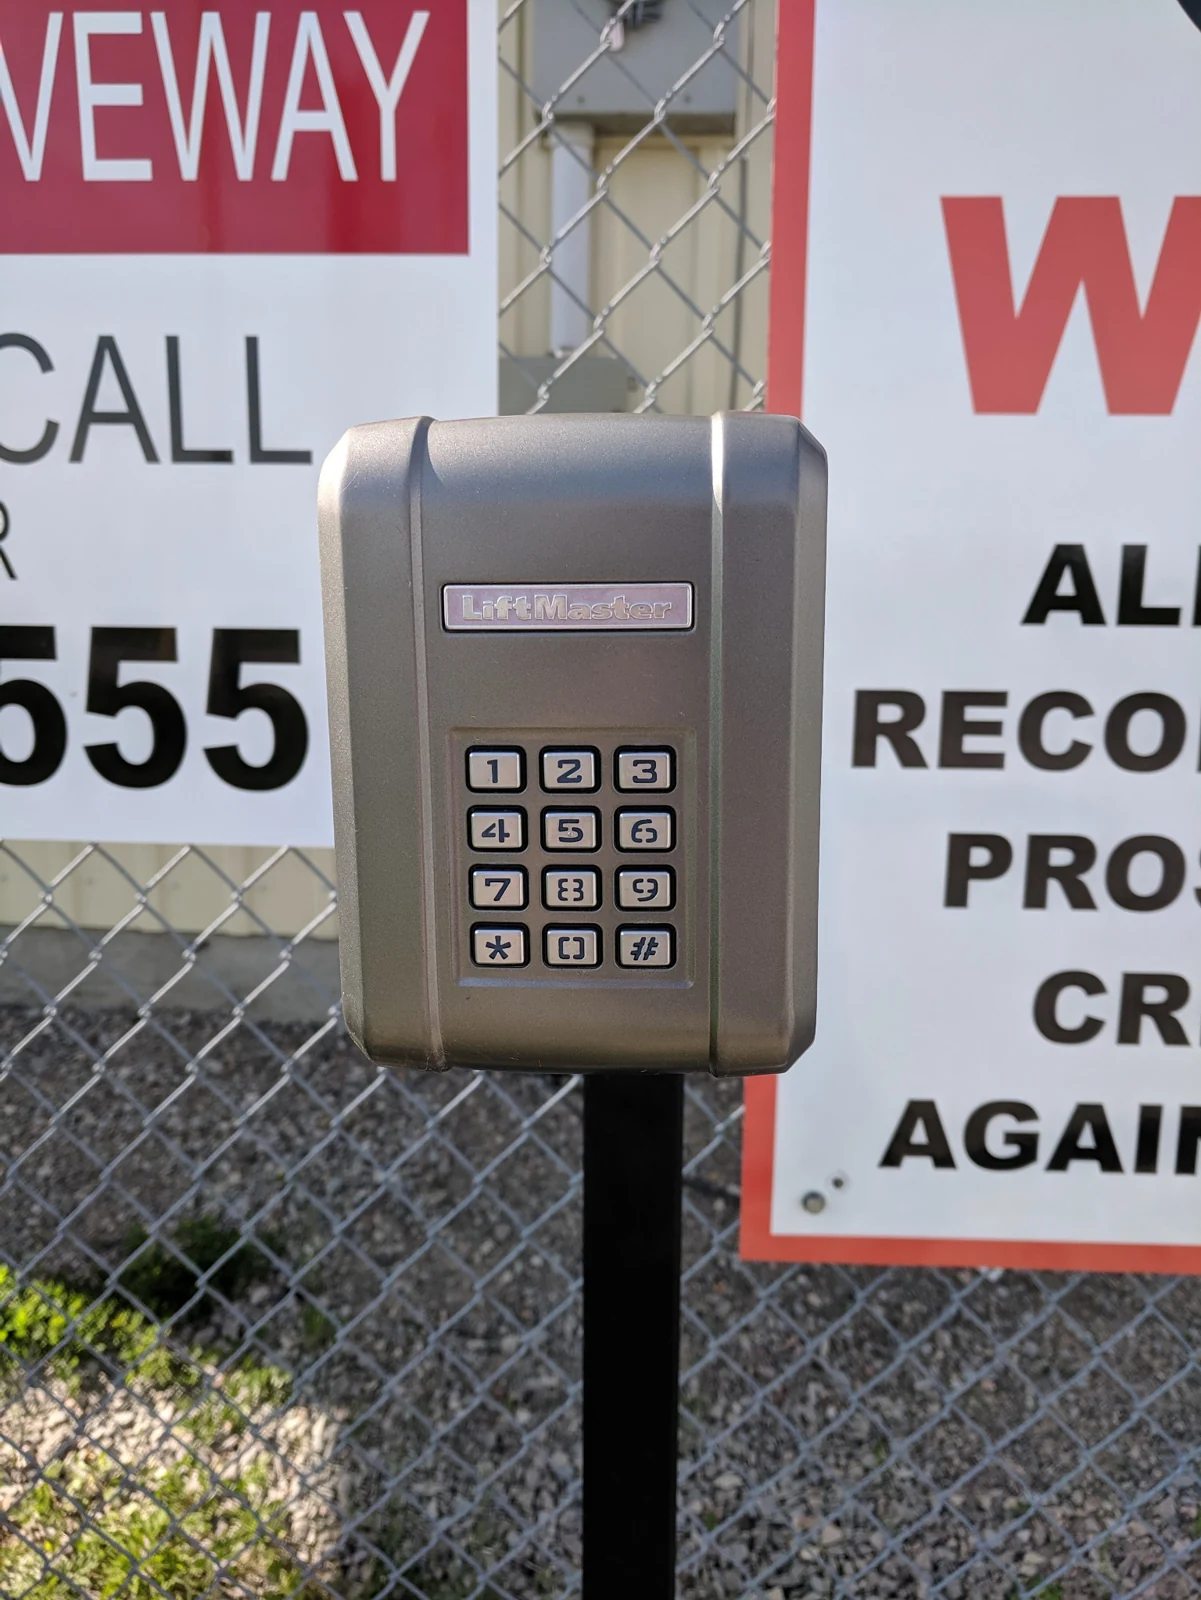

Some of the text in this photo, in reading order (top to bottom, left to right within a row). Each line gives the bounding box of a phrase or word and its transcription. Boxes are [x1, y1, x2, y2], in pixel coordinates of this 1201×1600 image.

[1020, 543, 1201, 627] AL
[462, 594, 672, 620] LiftMaster
[851, 689, 1201, 773] RECO
[486, 759, 658, 784] 1 2 3
[482, 819, 658, 844] 4 5 6
[943, 832, 1201, 913] PRO
[484, 878, 659, 902] 7 8 9
[631, 937, 659, 962] #
